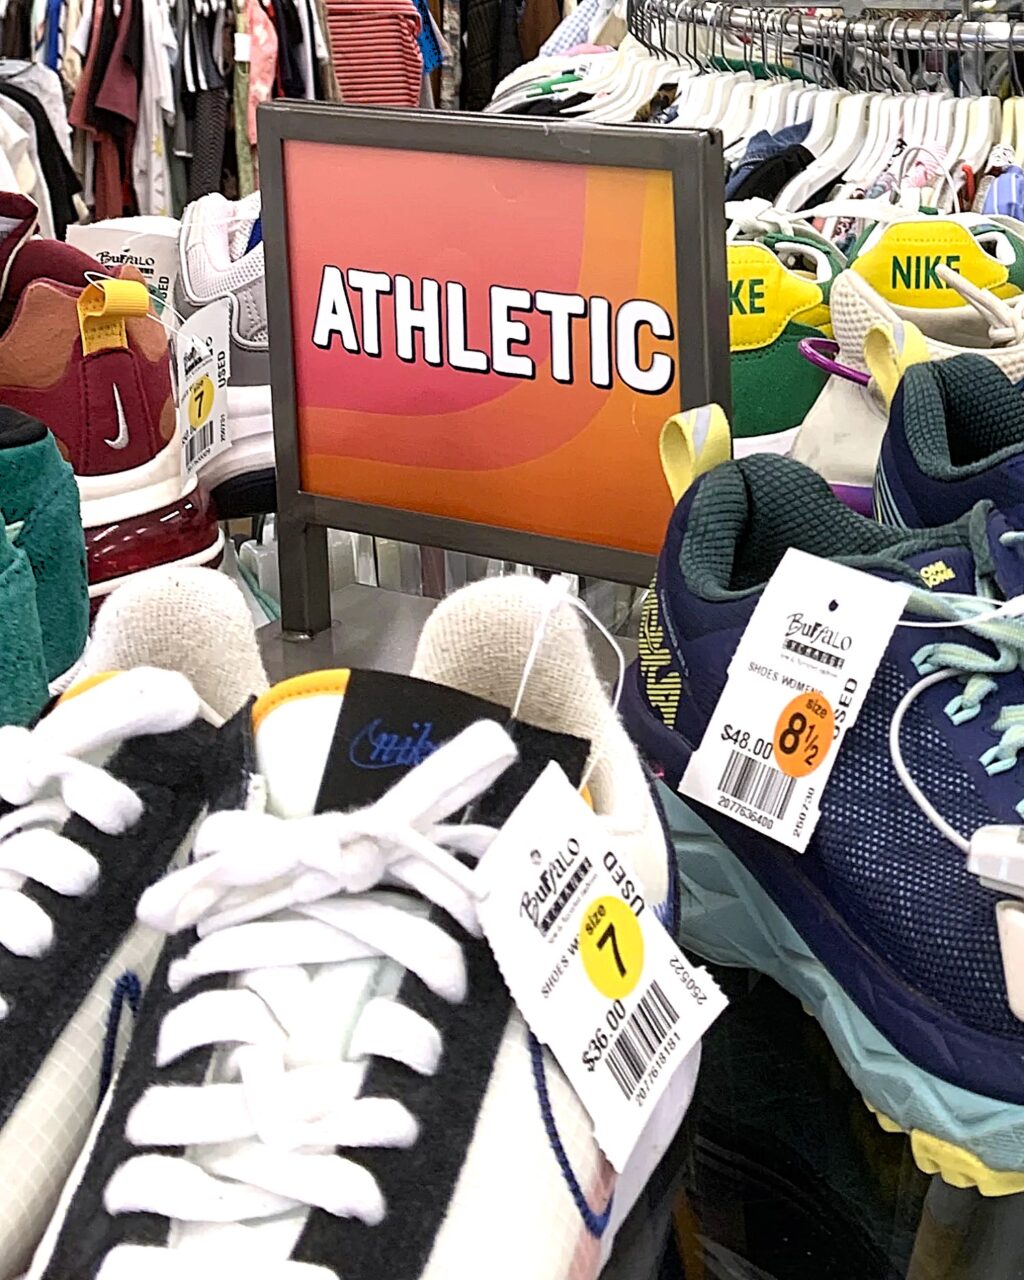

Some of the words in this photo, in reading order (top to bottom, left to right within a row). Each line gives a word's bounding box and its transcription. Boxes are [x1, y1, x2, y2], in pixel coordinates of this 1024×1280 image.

[311, 264, 675, 395] ATHLETIC
[217, 350, 227, 388] USED
[194, 389, 205, 418] 7
[747, 661, 780, 682] SHOES
[805, 698, 828, 719] size
[720, 723, 774, 760] $48.00
[603, 851, 645, 917] USED
[585, 904, 607, 936] size
[596, 922, 627, 978] 7
[541, 955, 569, 999] SHOES
[669, 954, 708, 1006] 250522
[581, 998, 627, 1072] $36.00
